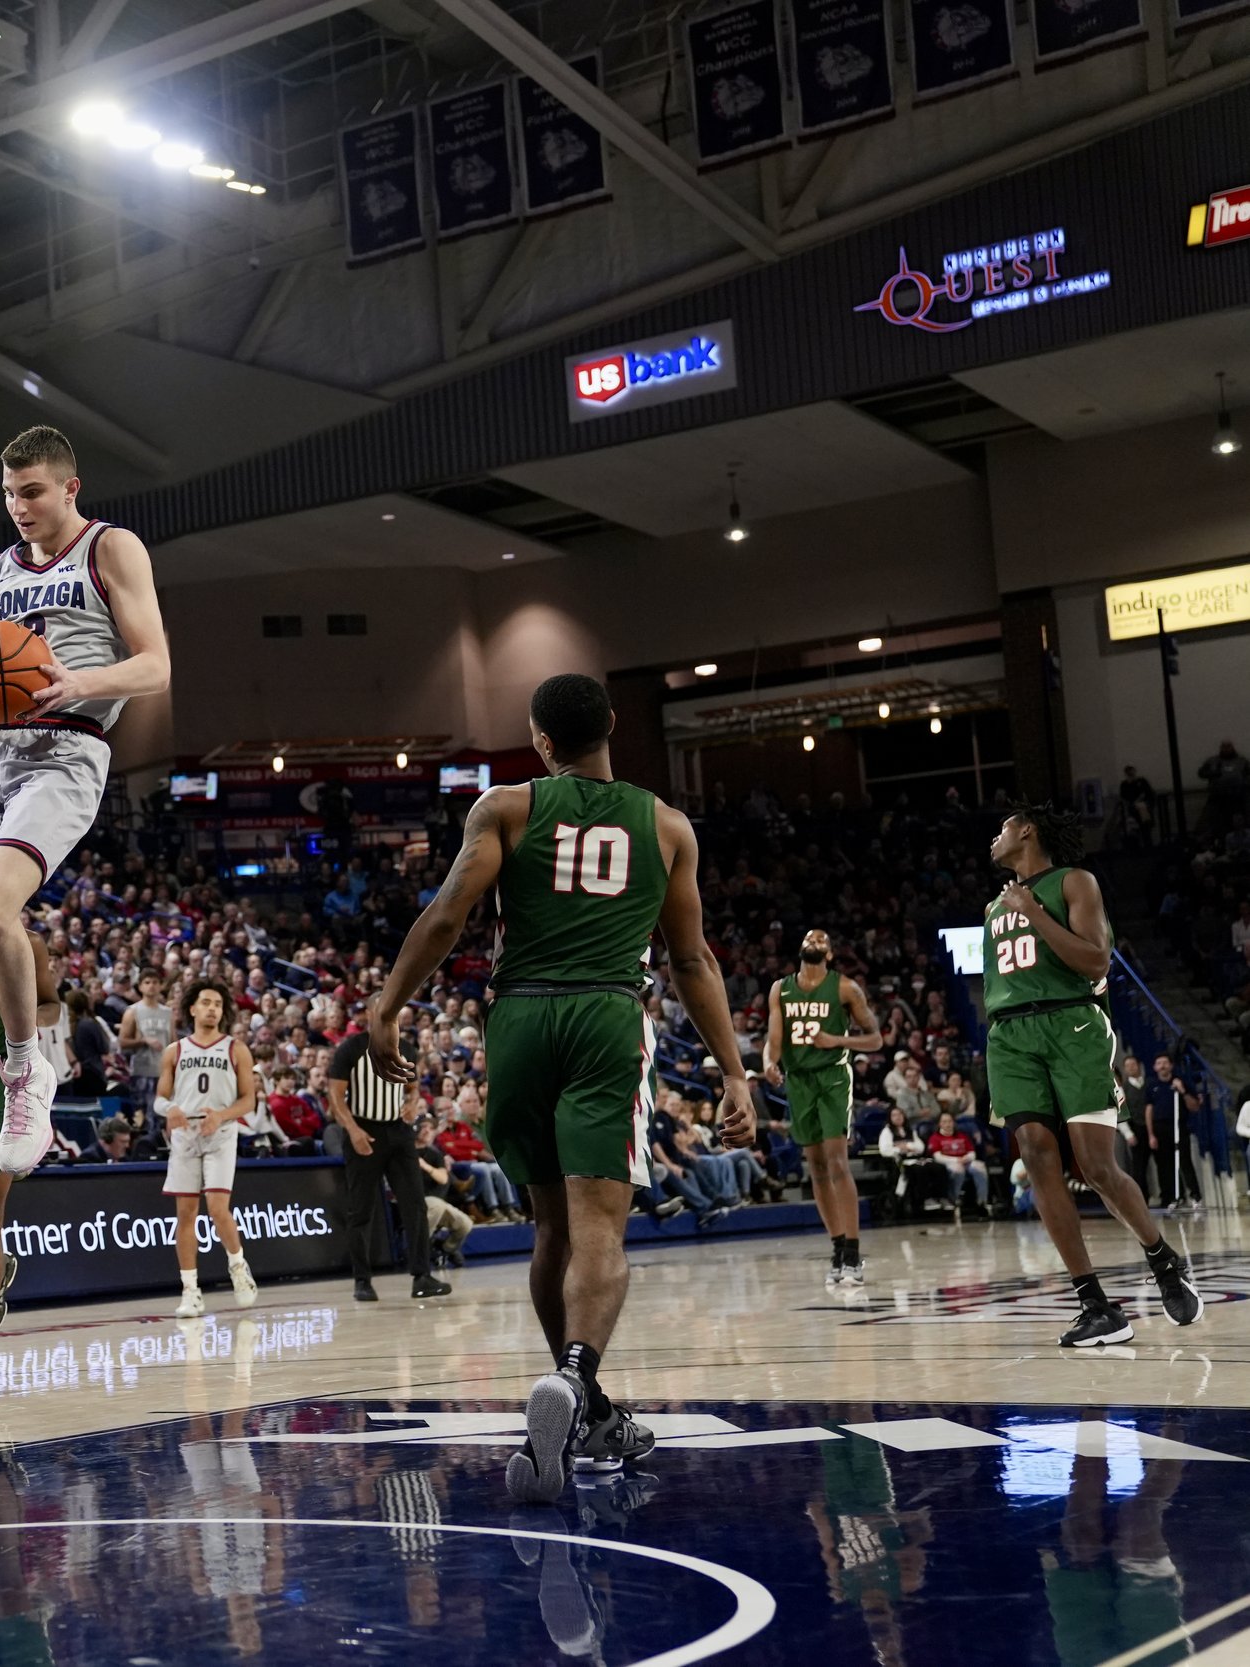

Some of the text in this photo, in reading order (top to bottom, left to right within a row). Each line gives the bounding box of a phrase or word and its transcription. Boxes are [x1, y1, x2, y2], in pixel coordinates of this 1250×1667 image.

[578, 336, 718, 396] us bank
[1186, 582, 1249, 603] URGEN
[1188, 599, 1236, 618] CARE
[553, 822, 630, 895] 10
[991, 911, 1029, 939] MVS
[996, 934, 1037, 975] 20
[785, 1002, 830, 1018] MVSU
[791, 1021, 821, 1045] 23
[180, 1056, 228, 1071] GONZAGA
[198, 1073, 209, 1094] 0
[0, 1220, 72, 1257] rtner
[79, 1211, 107, 1252] of
[112, 1212, 223, 1254] Gonzga
[231, 1202, 333, 1240] Athletics.
